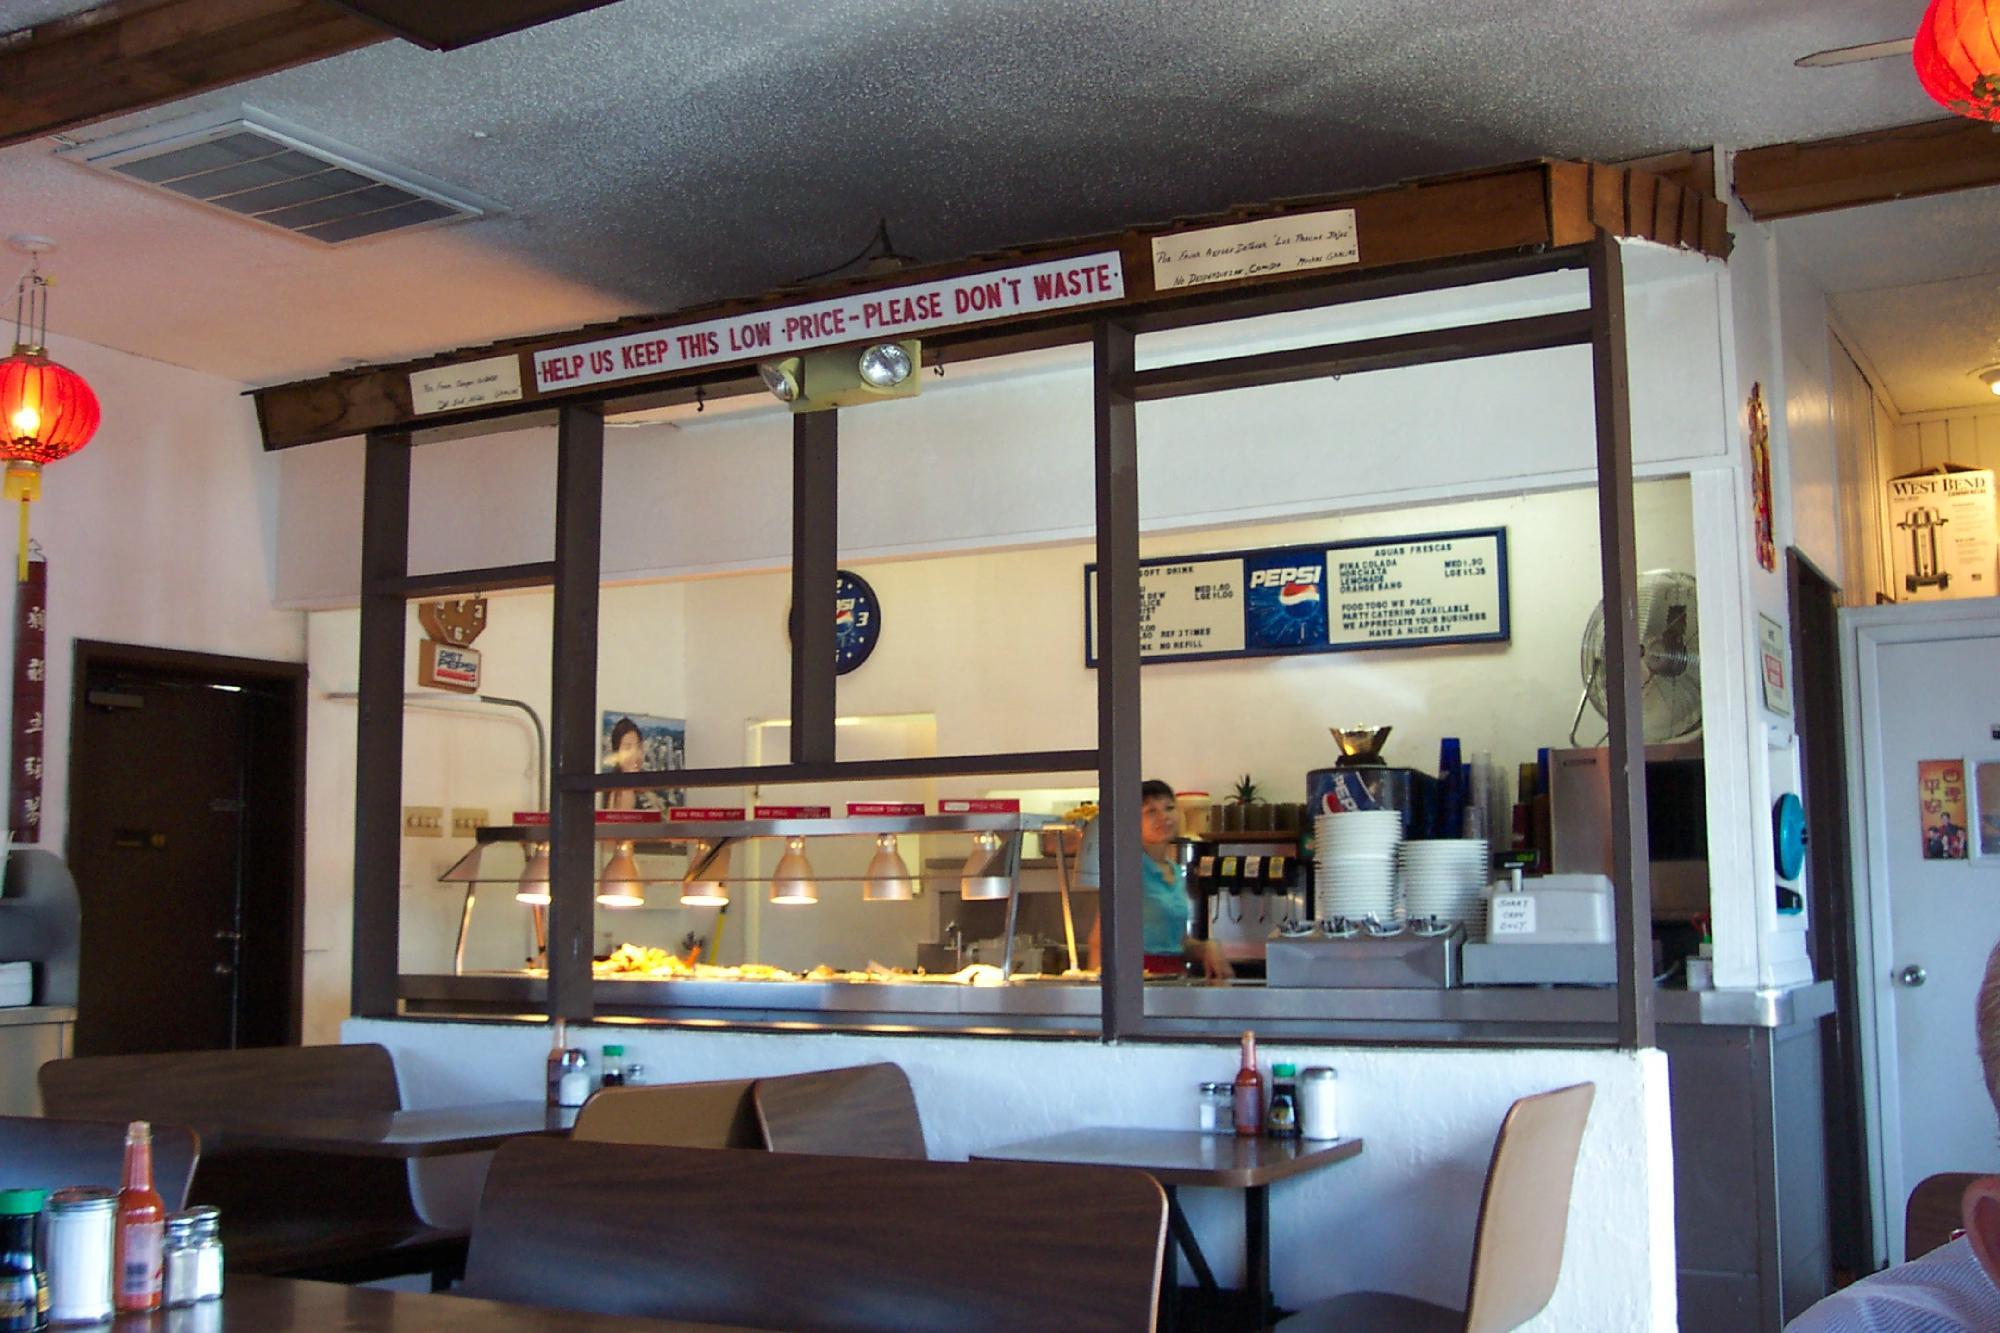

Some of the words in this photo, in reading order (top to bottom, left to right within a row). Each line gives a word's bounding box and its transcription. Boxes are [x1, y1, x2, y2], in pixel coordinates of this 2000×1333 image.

[541, 355, 585, 383] HELP
[590, 350, 613, 375] US
[622, 336, 669, 370] KEEP
[677, 331, 719, 360] THIS
[730, 321, 770, 352] LOW
[954, 276, 1021, 315] DON'T
[1893, 481, 1938, 496] WEST
[1943, 477, 1985, 492] BEND
[1250, 566, 1322, 589] PEPSI
[856, 611, 870, 627] 3
